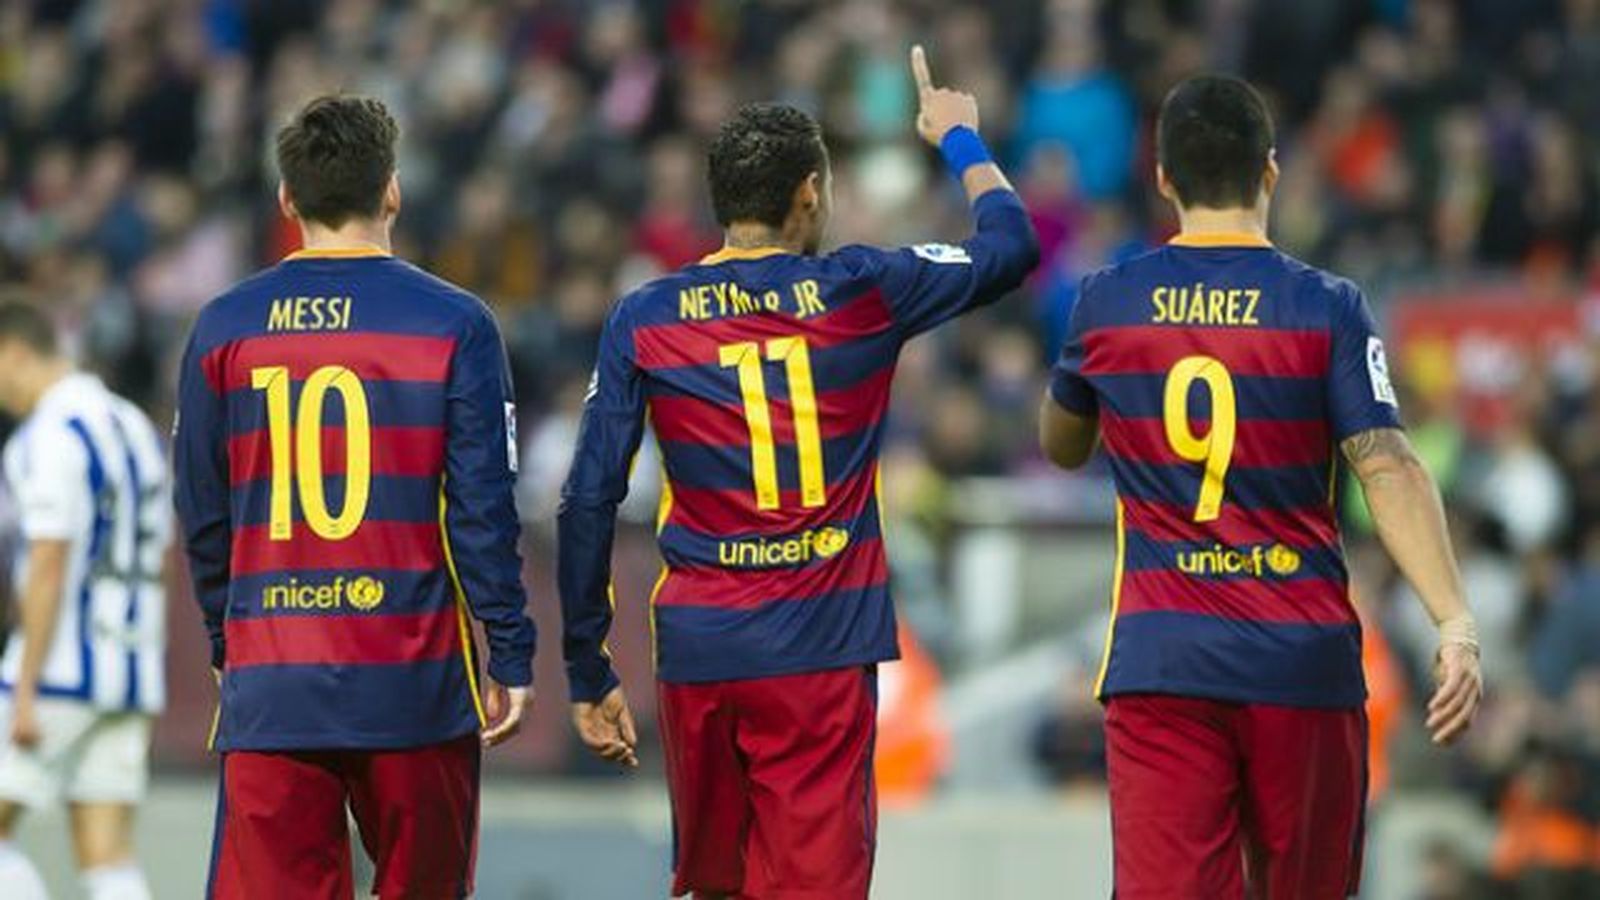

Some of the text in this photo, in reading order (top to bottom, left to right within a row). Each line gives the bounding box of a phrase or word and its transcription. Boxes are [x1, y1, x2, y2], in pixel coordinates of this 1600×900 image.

[267, 296, 352, 331] MESSI
[679, 279, 826, 320] NEYMR JR
[1152, 282, 1261, 325] SUÁREZ
[719, 335, 826, 510] 11
[1163, 355, 1236, 522] 9
[251, 365, 371, 541] 10
[719, 529, 814, 564] unicef
